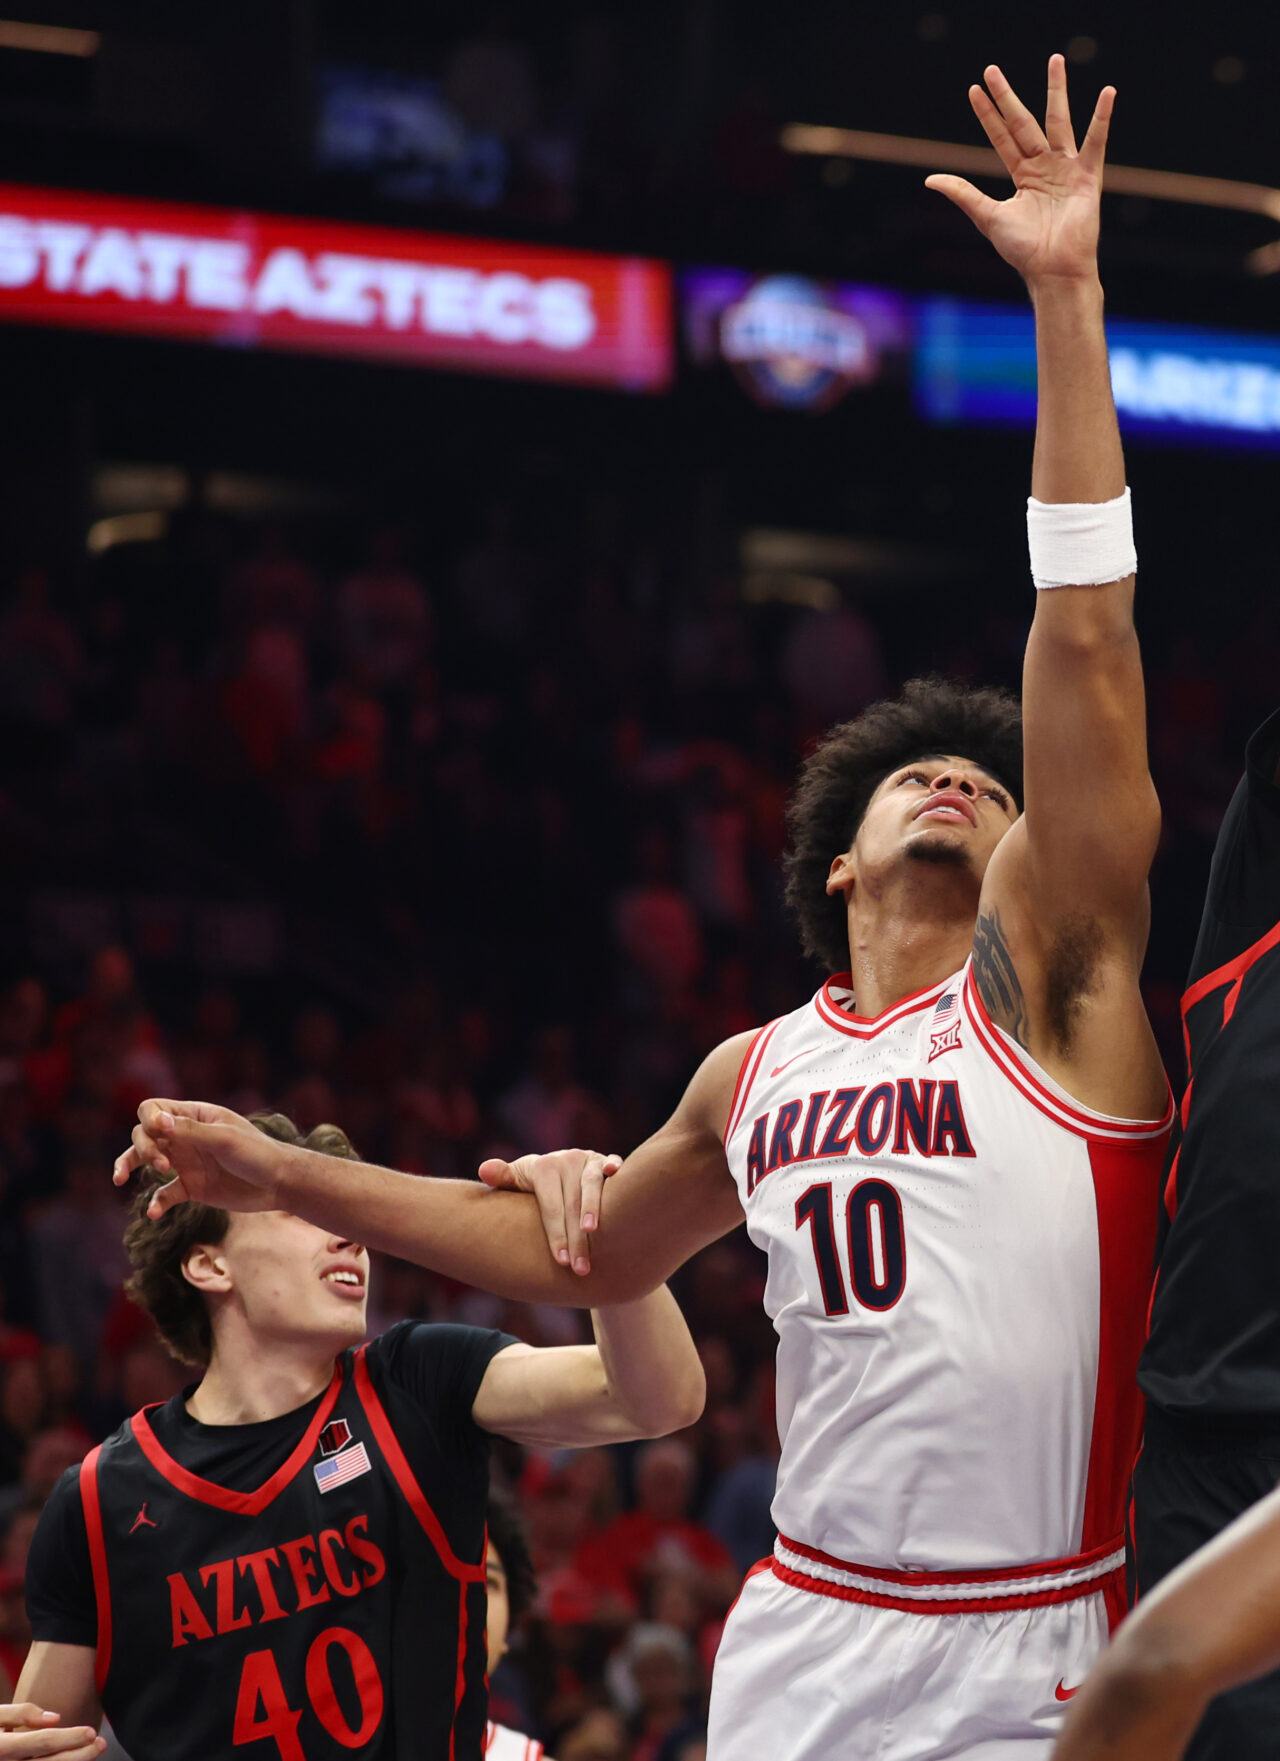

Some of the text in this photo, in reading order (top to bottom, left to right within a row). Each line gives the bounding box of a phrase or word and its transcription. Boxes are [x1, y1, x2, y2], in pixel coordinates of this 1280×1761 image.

[0, 213, 252, 312] STATE
[253, 246, 597, 351] AZTECS
[747, 1078, 977, 1198] ARIZONA
[794, 1178, 907, 1317] 10
[166, 1514, 387, 1648] AZTECS
[232, 1626, 385, 1761] 40
